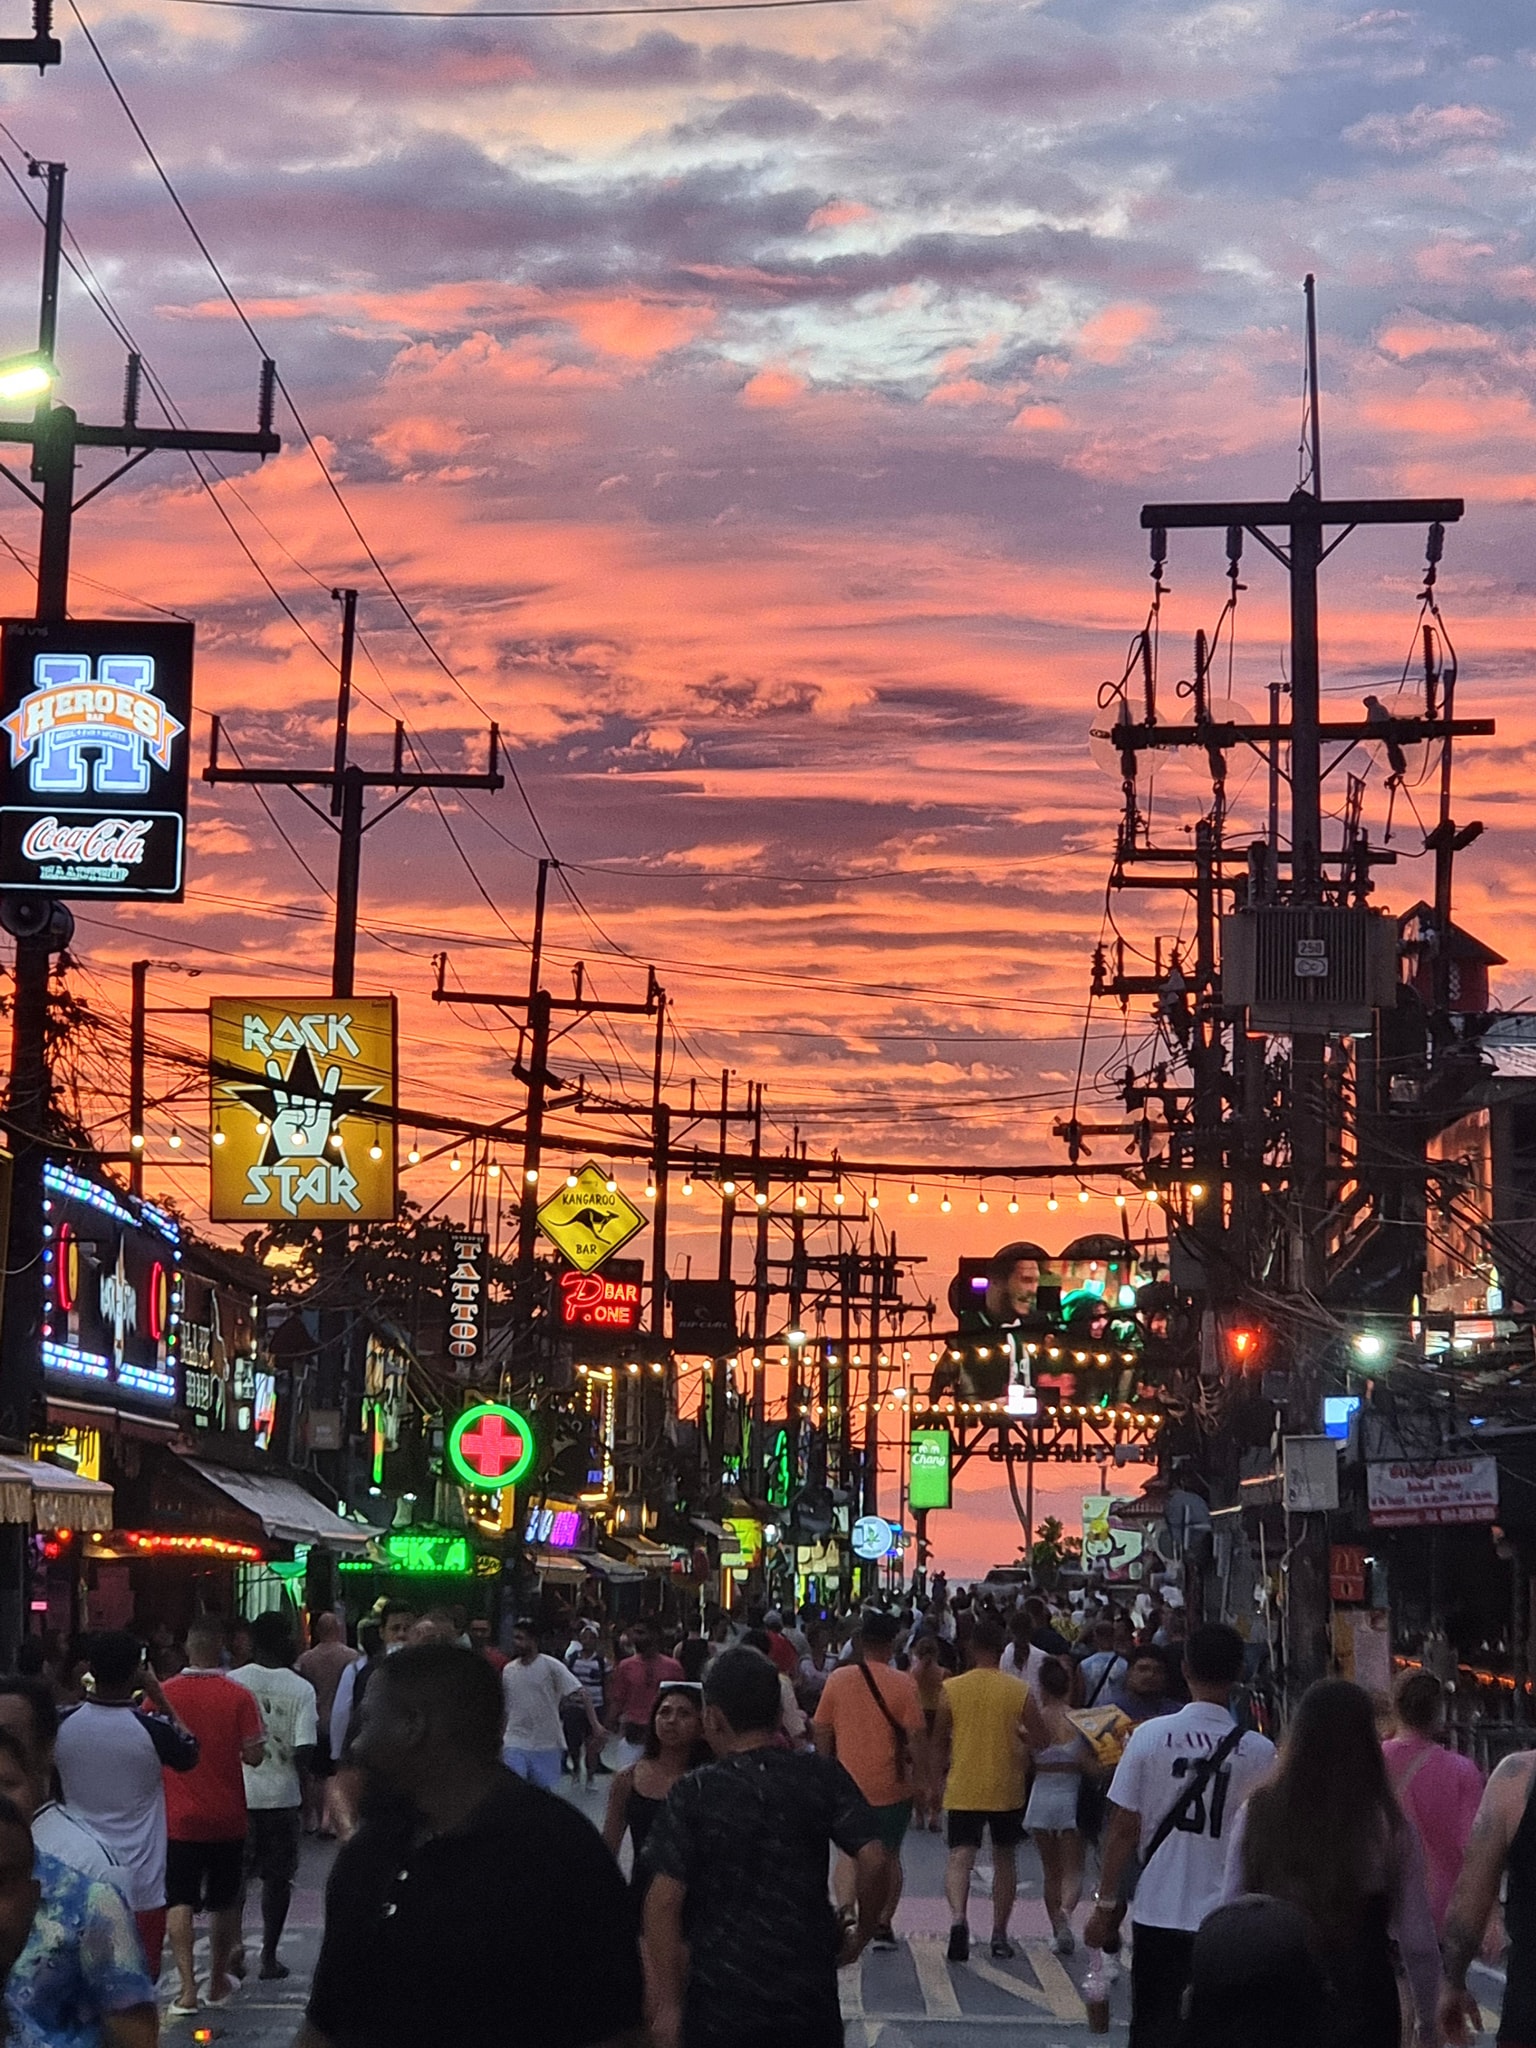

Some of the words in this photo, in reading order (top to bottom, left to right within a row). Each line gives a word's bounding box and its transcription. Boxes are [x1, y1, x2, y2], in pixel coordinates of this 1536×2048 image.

[26, 689, 158, 737] HEROES
[243, 1013, 361, 1057] ROCK
[242, 1165, 362, 1216] STAR
[562, 1194, 615, 1205] KANGAROO
[576, 1244, 597, 1254] BAR
[449, 1241, 481, 1357] TATTOO
[604, 1283, 637, 1302] BAR
[594, 1306, 630, 1323] ONE
[912, 1453, 946, 1467] Chang
